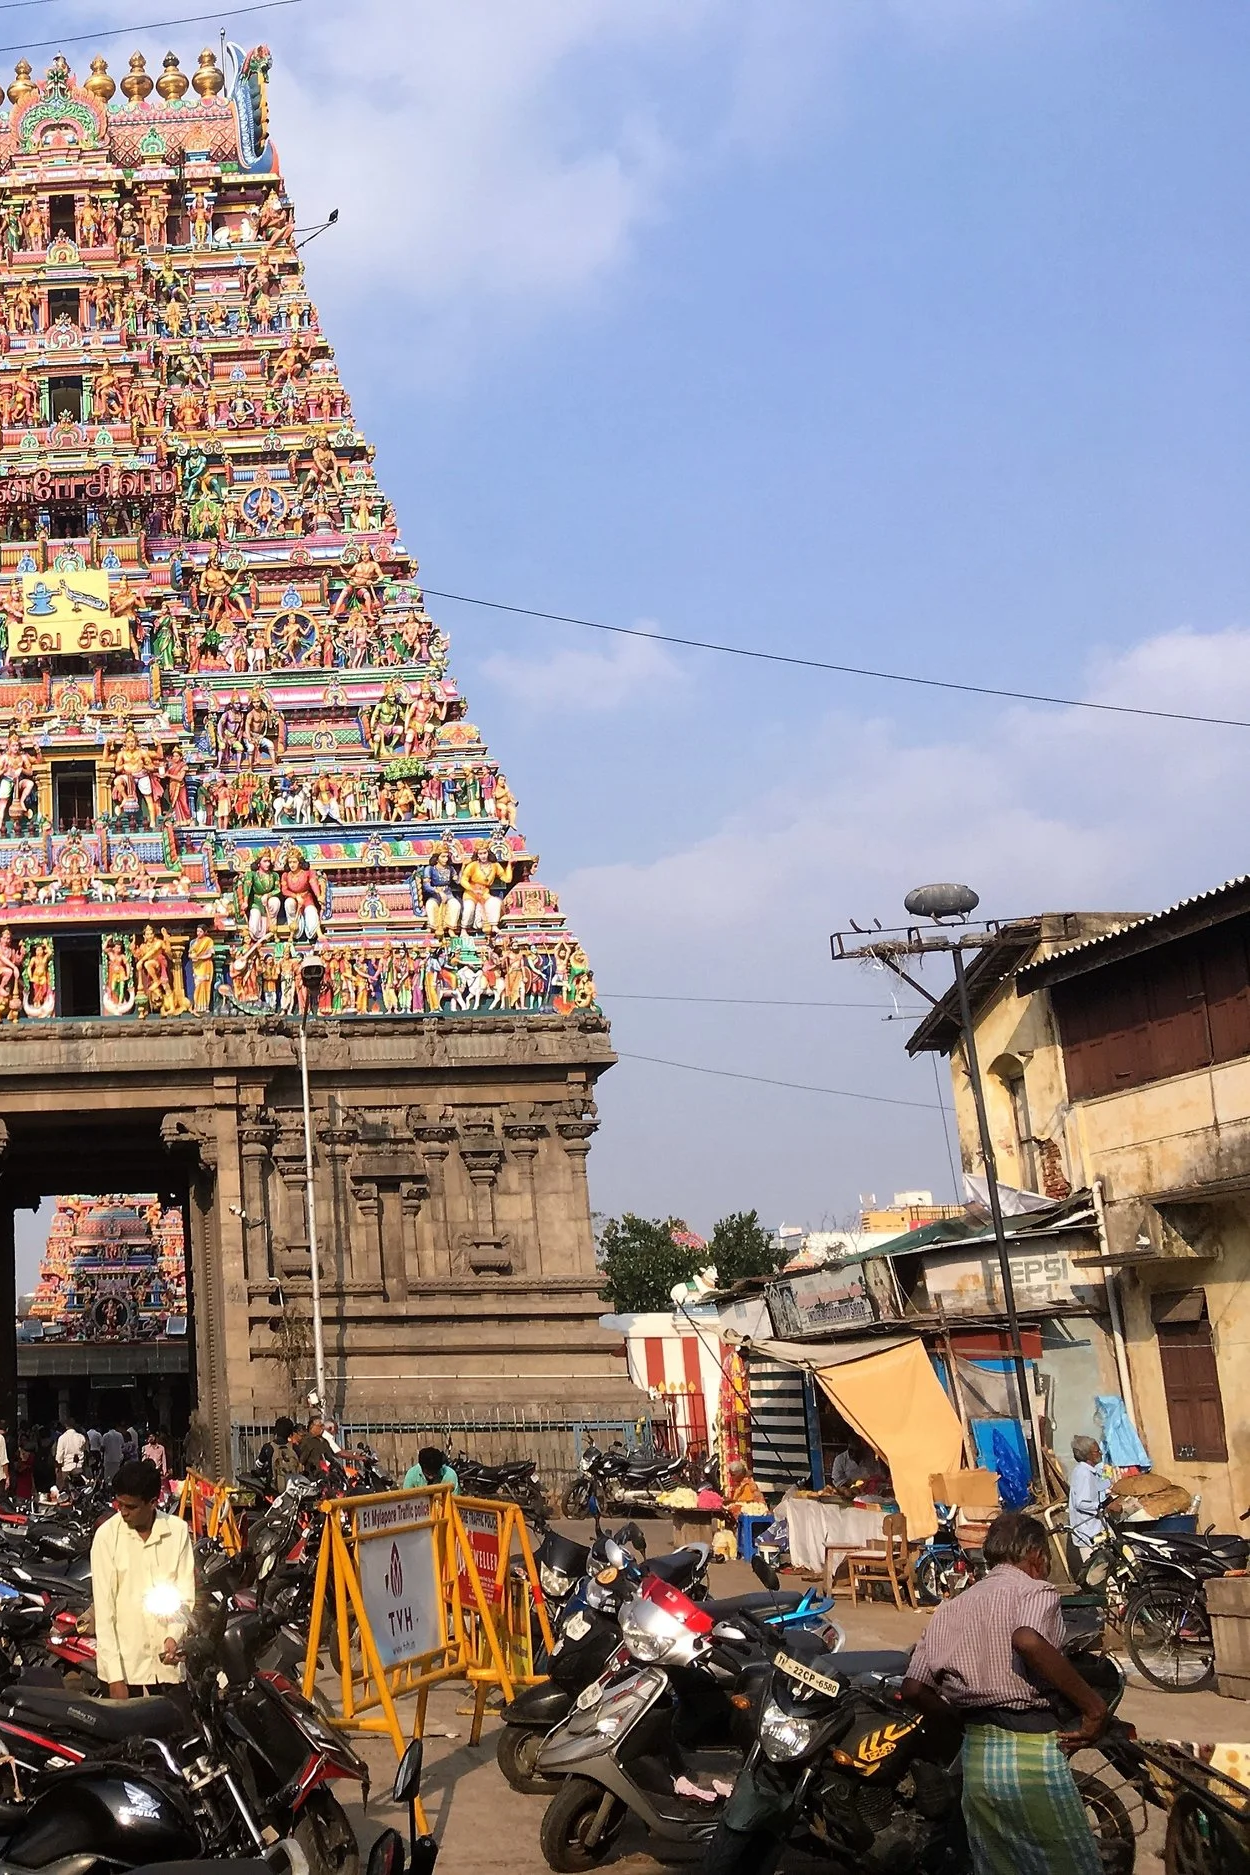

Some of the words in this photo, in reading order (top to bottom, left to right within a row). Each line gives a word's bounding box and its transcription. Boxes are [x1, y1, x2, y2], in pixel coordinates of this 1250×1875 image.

[17, 625, 61, 653] சிவ
[77, 622, 122, 649] சிவ
[371, 1508, 397, 1529] Mylapore
[397, 1502, 414, 1521] Traffic
[388, 1606, 414, 1637] TVH
